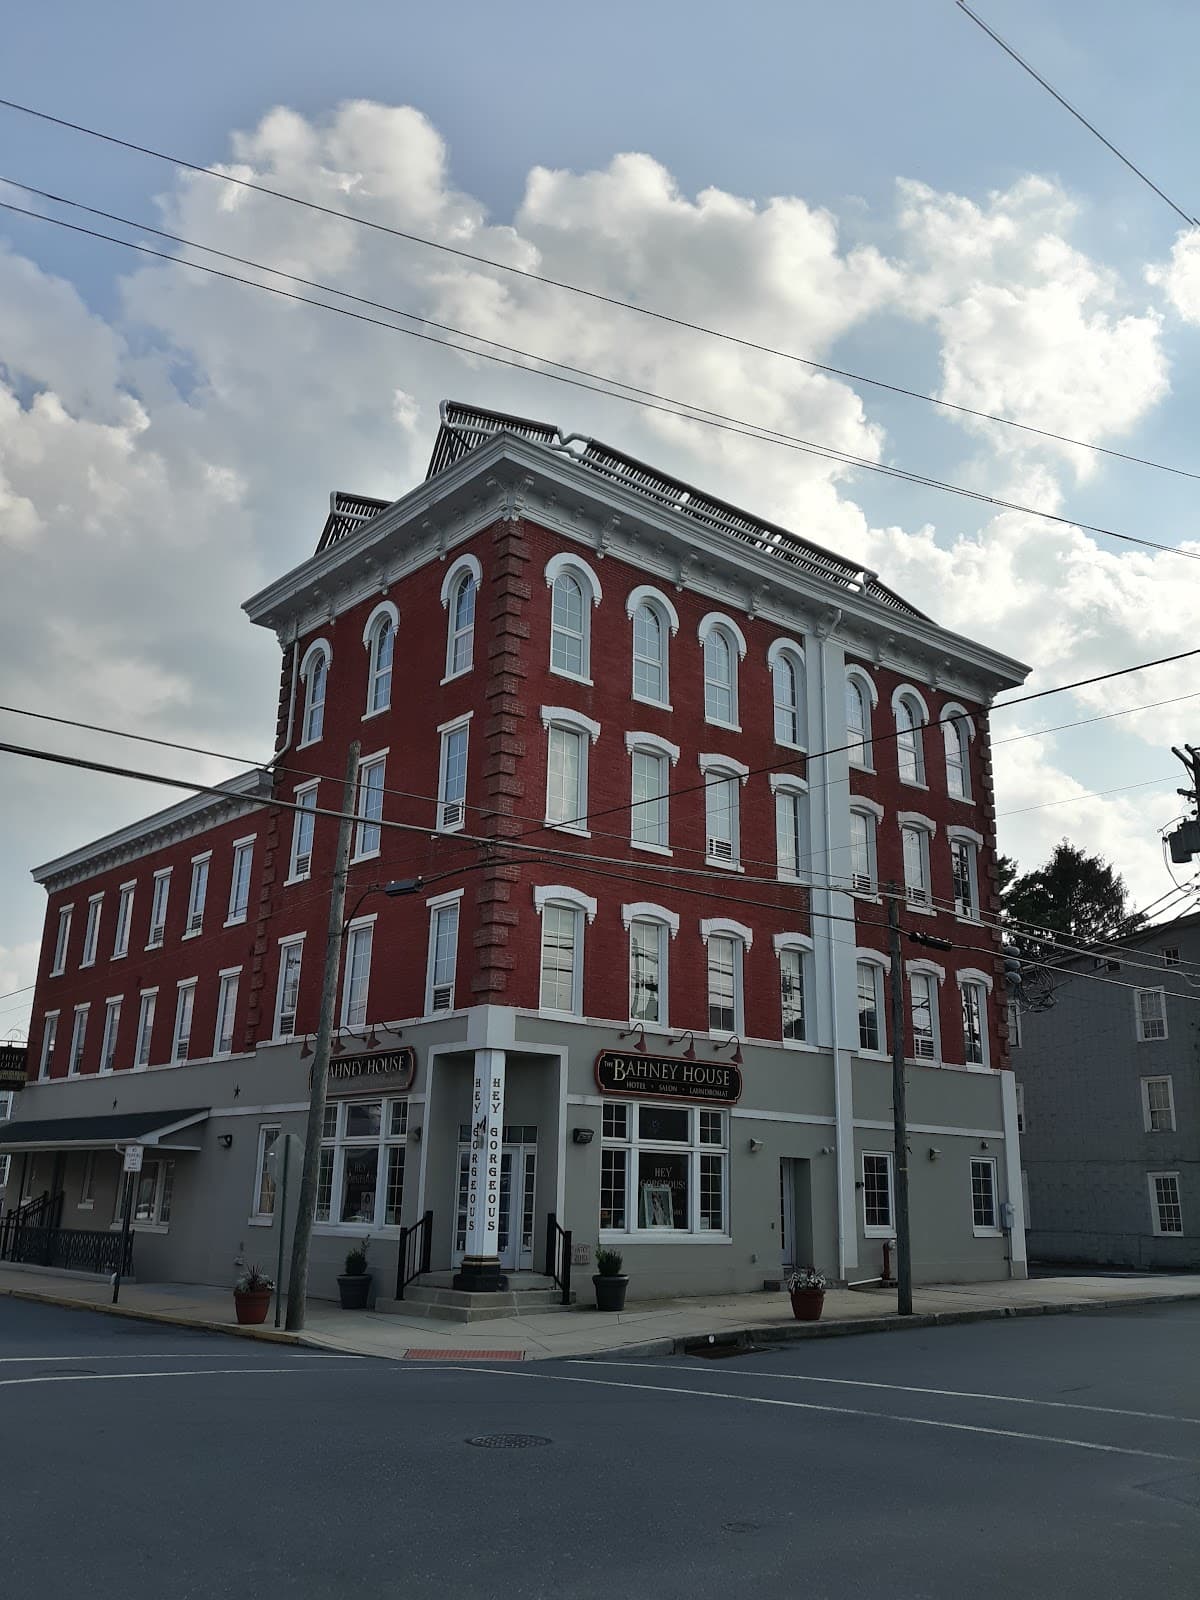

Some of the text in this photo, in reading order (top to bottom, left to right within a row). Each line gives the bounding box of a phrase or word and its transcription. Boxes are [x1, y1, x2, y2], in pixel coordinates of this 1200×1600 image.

[328, 1055, 404, 1078] AHNEY HOUSE
[604, 1058, 730, 1086] THE BAHNEY HOUSE
[626, 1080, 729, 1097] HOTEL SALON LAUNDROMAT
[487, 1078, 501, 1231] HEY GORGEOUS
[468, 1127, 479, 1231] GORGEOUS
[654, 1166, 673, 1177] HEY
